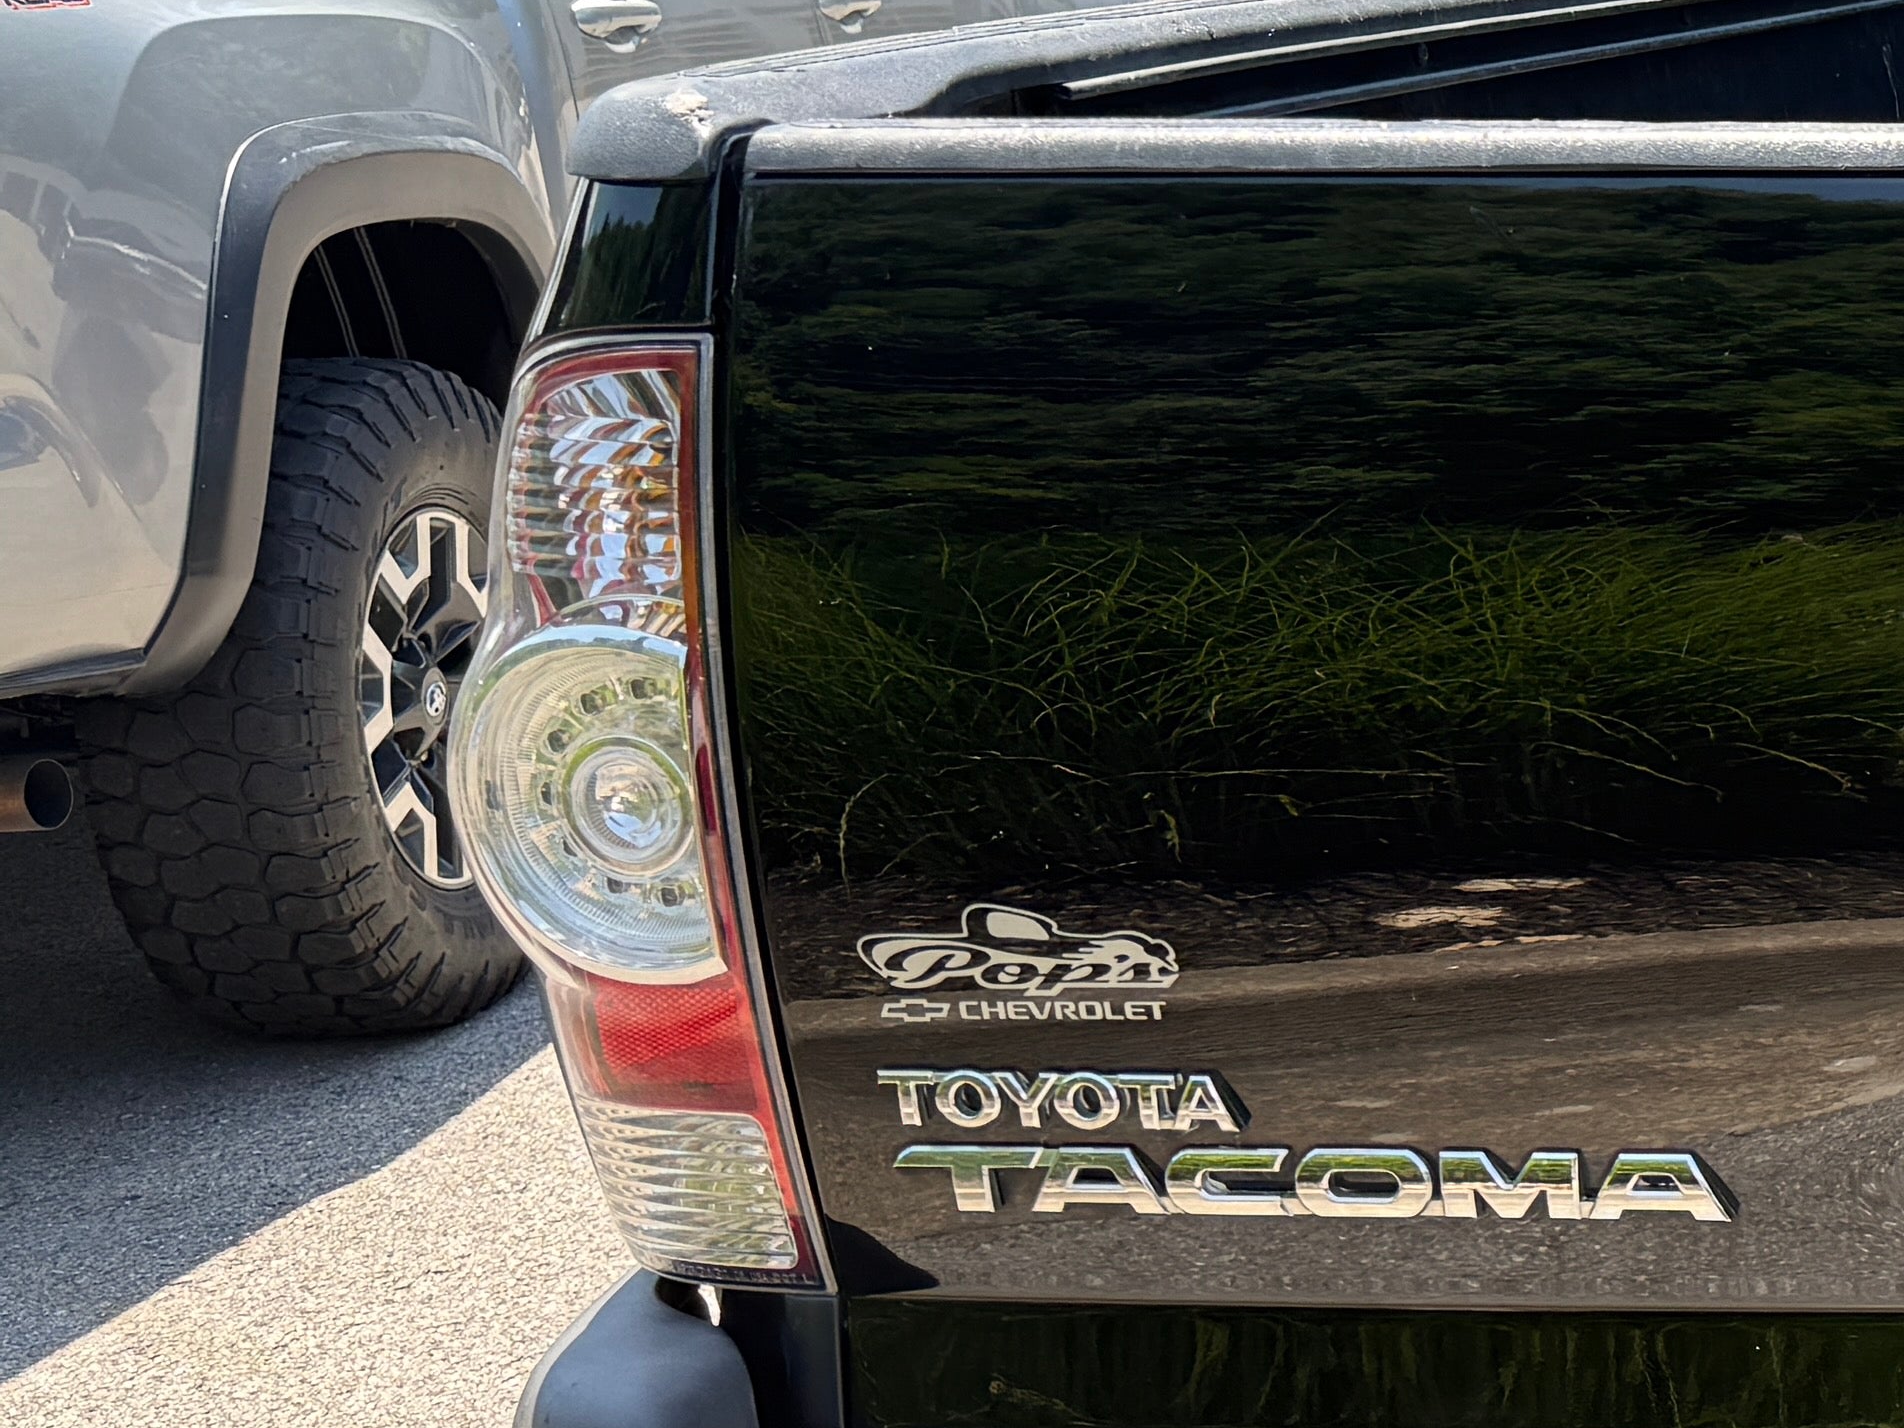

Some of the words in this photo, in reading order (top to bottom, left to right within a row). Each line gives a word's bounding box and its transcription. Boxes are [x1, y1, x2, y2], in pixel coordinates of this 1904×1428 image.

[958, 1000, 1167, 1021] CHEVROLET
[876, 1068, 1251, 1133] TOYOTA
[893, 1144, 1738, 1222] TACOMA
